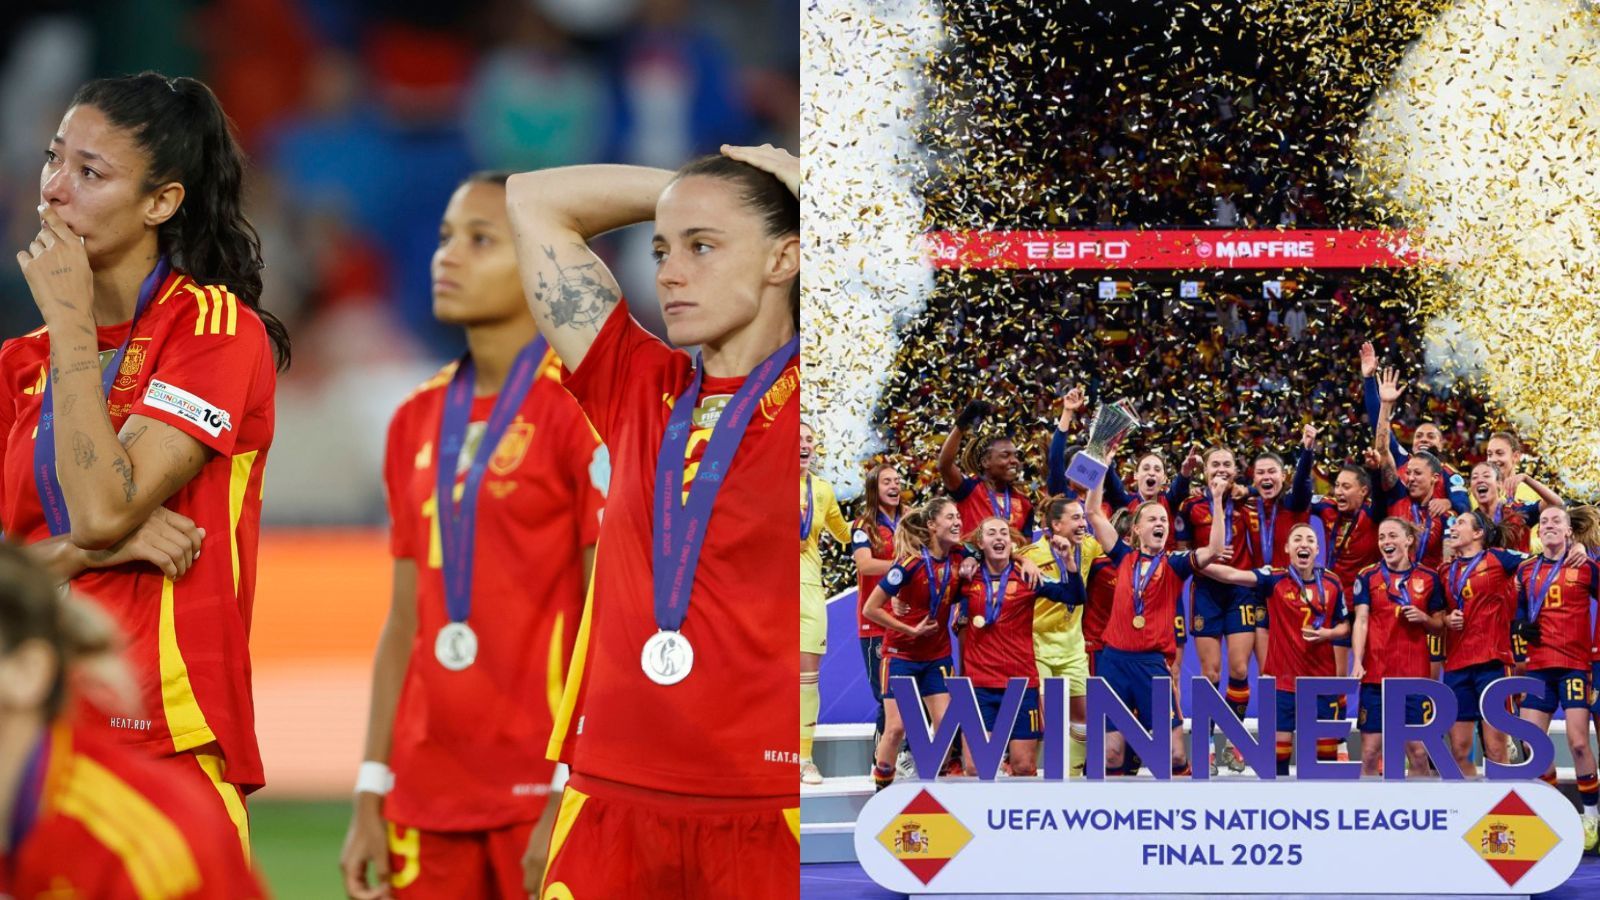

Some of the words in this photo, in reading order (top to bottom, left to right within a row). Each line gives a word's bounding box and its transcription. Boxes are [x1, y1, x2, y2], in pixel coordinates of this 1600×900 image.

[1215, 241, 1314, 258] MAPFRE
[149, 389, 202, 416] FOUNDATION
[203, 408, 222, 428] 10
[1239, 605, 1255, 626] 16
[1565, 678, 1585, 701] 19
[887, 676, 1556, 780] WINNERS
[764, 749, 800, 765] HEAT.R
[987, 809, 1058, 830] UEFA
[1061, 809, 1197, 830] WOMEN'S
[1205, 809, 1330, 830] NATIONS
[1338, 809, 1448, 830] LEAGUE
[1142, 844, 1224, 866] FINAL
[1231, 844, 1303, 866] 2025
